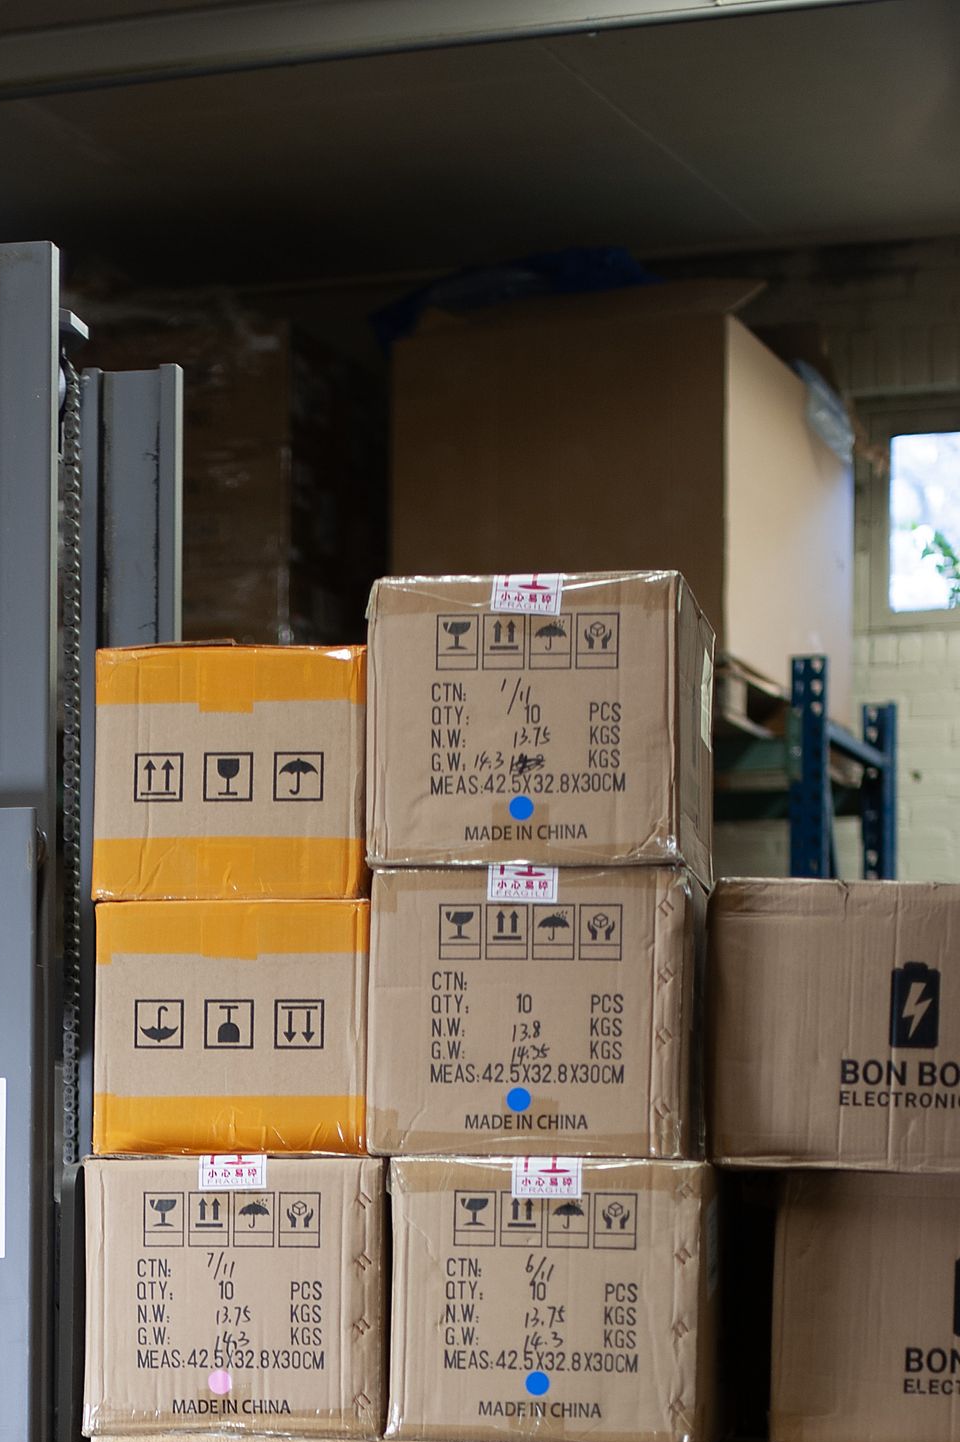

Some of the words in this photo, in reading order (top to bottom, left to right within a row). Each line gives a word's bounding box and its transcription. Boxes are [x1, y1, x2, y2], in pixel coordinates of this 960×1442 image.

[432, 683, 466, 702] CTN:
[432, 706, 469, 725] QTY:
[525, 704, 541, 724] 10
[589, 702, 622, 722] PCS
[590, 725, 620, 745] KGS
[588, 749, 620, 768] KGS
[464, 825, 512, 842] MADE
[517, 825, 532, 841] IN
[537, 824, 588, 841] CHINA
[432, 972, 467, 991] CTN:
[431, 995, 469, 1014] QTY:
[517, 993, 532, 1013] 10
[591, 994, 624, 1014] PCS
[512, 1020, 541, 1042] 13.8
[590, 1018, 622, 1037] KGS
[590, 1041, 622, 1060] KGS
[841, 1059, 907, 1085] BON
[840, 1091, 960, 1108] ELECTRONI
[464, 1114, 512, 1130] MADE
[517, 1114, 532, 1130] IN
[537, 1114, 588, 1130] CHINA
[137, 1259, 171, 1277] CTN:
[446, 1258, 482, 1277] CTN:
[137, 1281, 173, 1300] QTY:
[219, 1280, 234, 1299] 10
[291, 1281, 322, 1300] PCS
[446, 1281, 483, 1300] QTY:
[530, 1282, 546, 1301] 10
[605, 1283, 638, 1303] PCS
[216, 1305, 251, 1326] 13.75
[290, 1304, 322, 1323] KGS
[525, 1305, 565, 1328] 13.75
[604, 1306, 636, 1325] KGS
[291, 1327, 322, 1345] KGS
[604, 1330, 636, 1349] KGS
[172, 1399, 219, 1414] MADE
[222, 1400, 238, 1414] IN
[242, 1399, 290, 1414] CHINA
[479, 1401, 526, 1417] MADE
[531, 1402, 546, 1417] IN
[551, 1403, 602, 1418] CHINA
